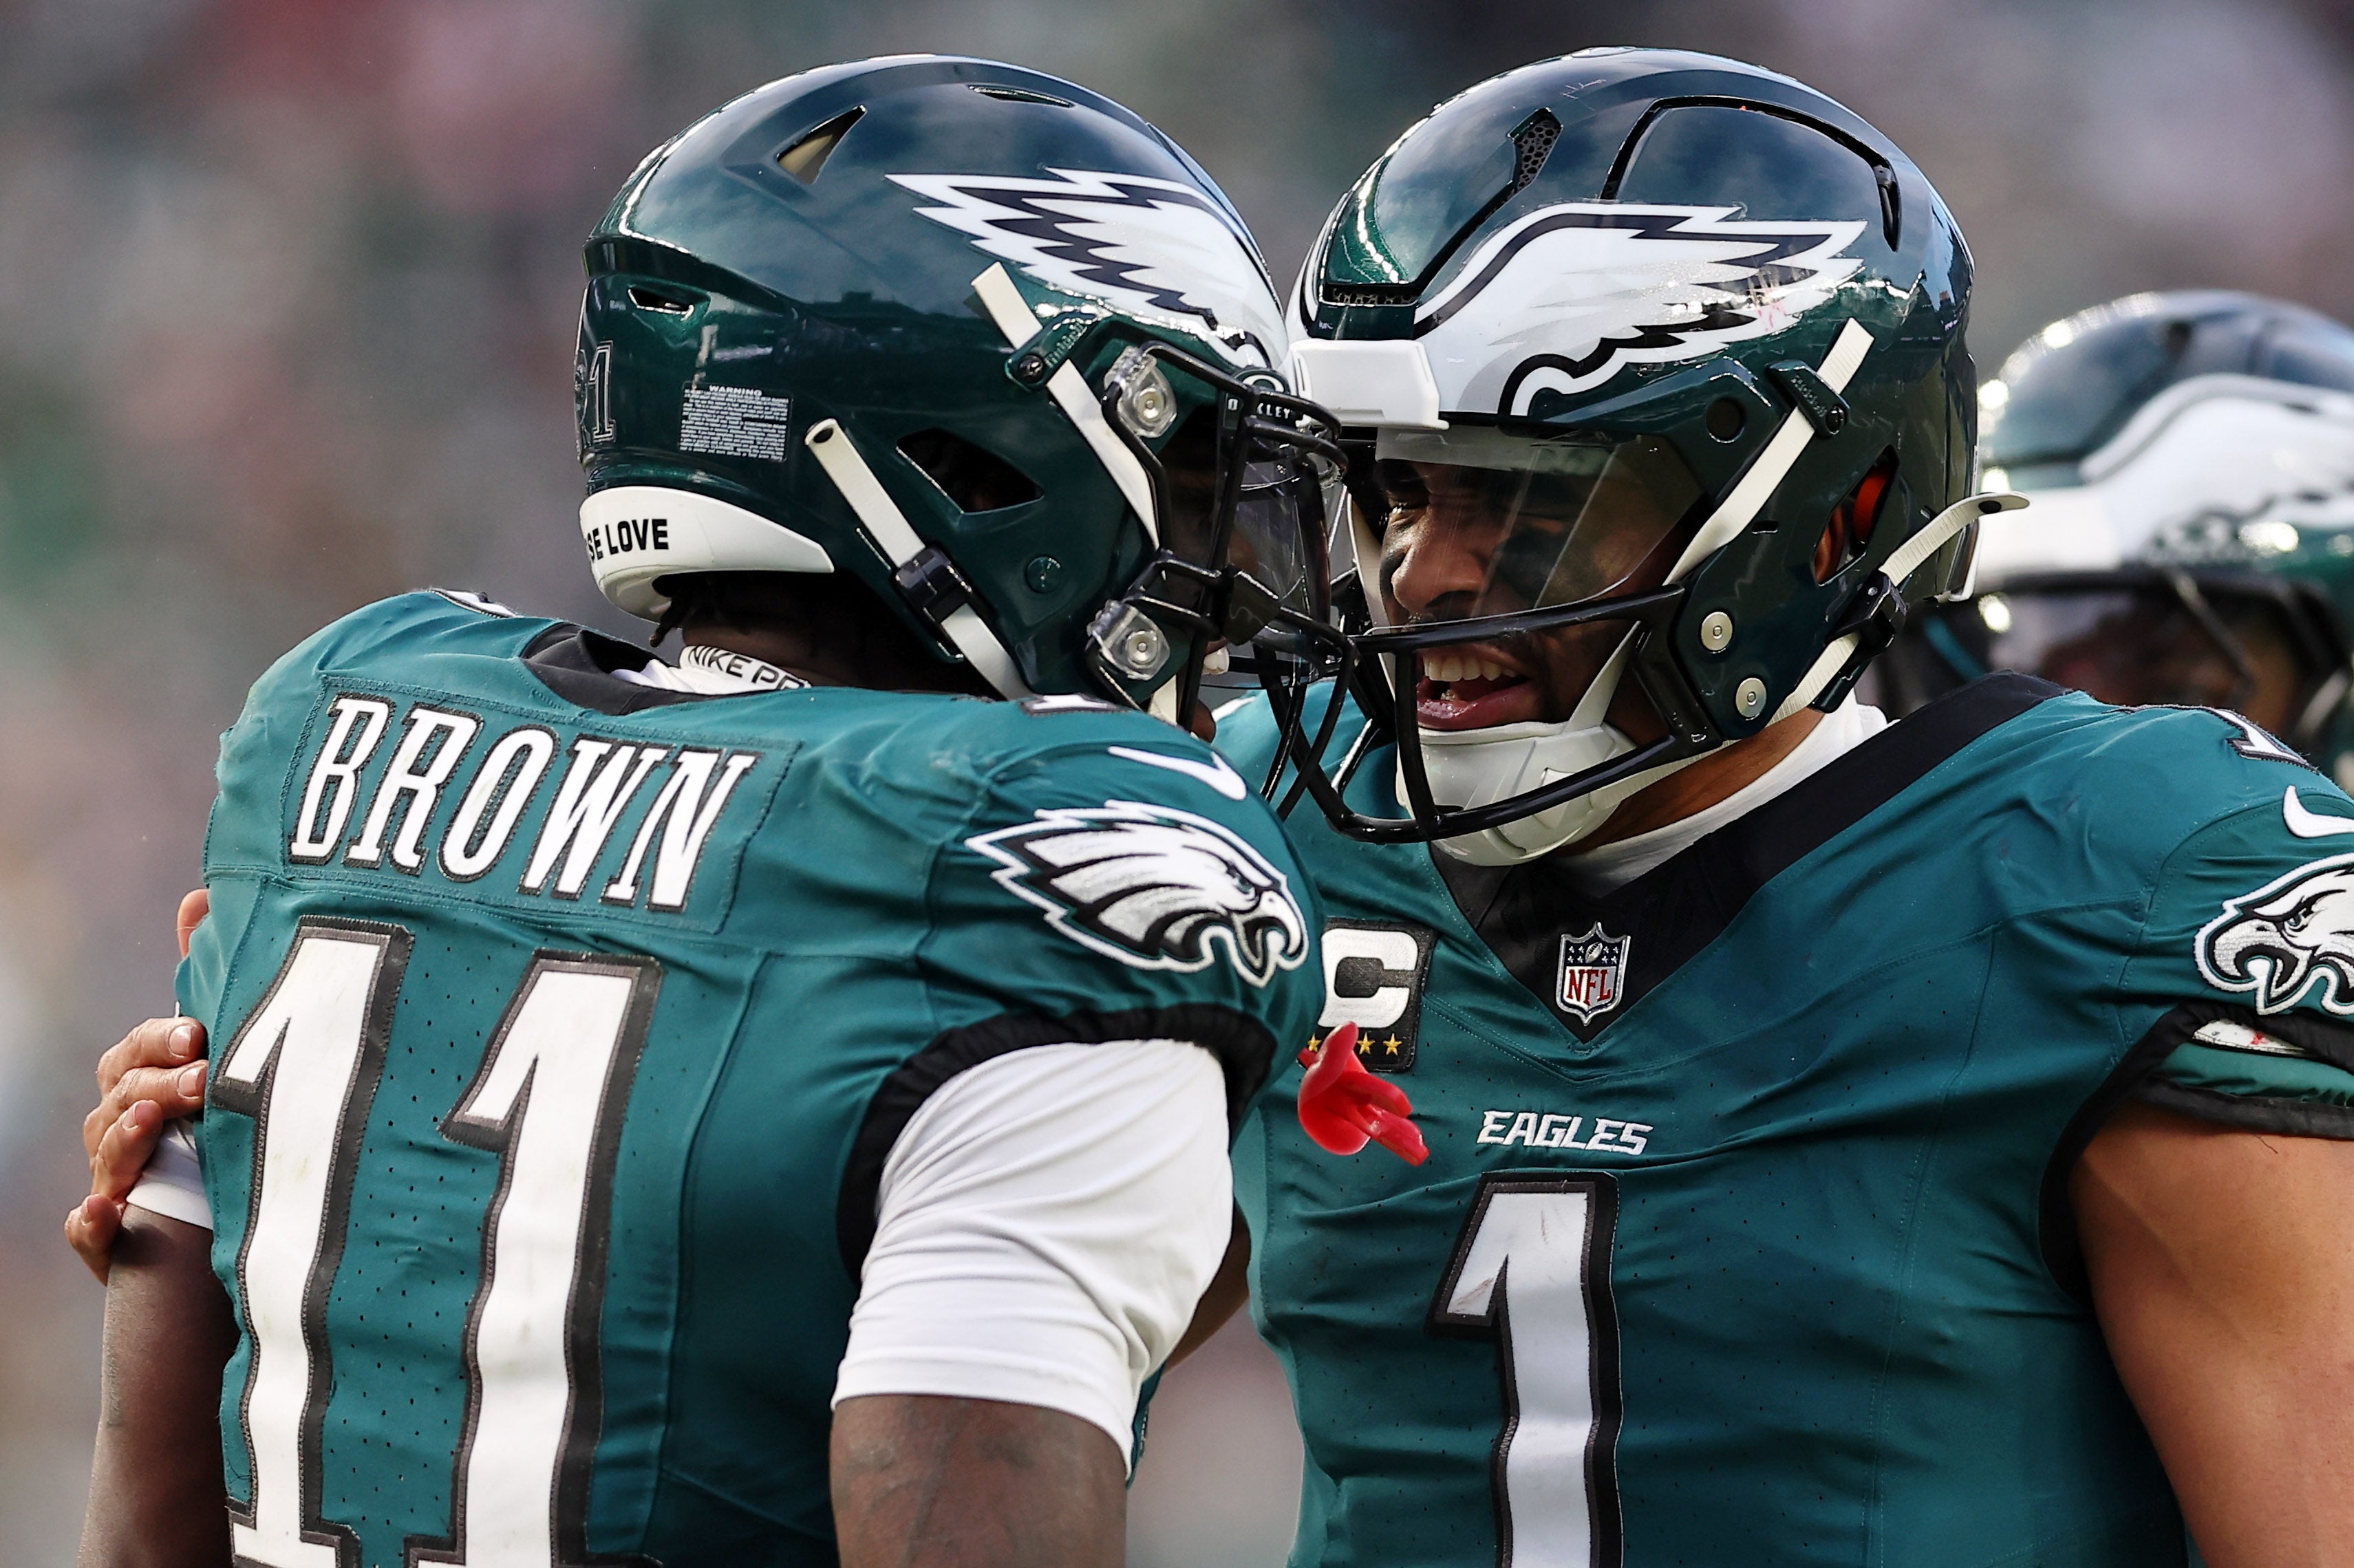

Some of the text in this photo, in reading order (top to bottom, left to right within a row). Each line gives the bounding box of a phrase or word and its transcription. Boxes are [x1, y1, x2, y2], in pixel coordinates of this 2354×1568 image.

[709, 385, 762, 397] WARNING
[1228, 398, 1291, 420] OKLEY
[605, 518, 670, 556] LOVE
[688, 645, 752, 678] NIKE
[289, 691, 762, 914] BROWN
[1318, 927, 1419, 1029] C
[1566, 968, 1612, 1007] NFL
[1477, 1109, 1654, 1157] EAGLES
[208, 914, 665, 1568] 11
[1424, 1171, 1623, 1568] 1
